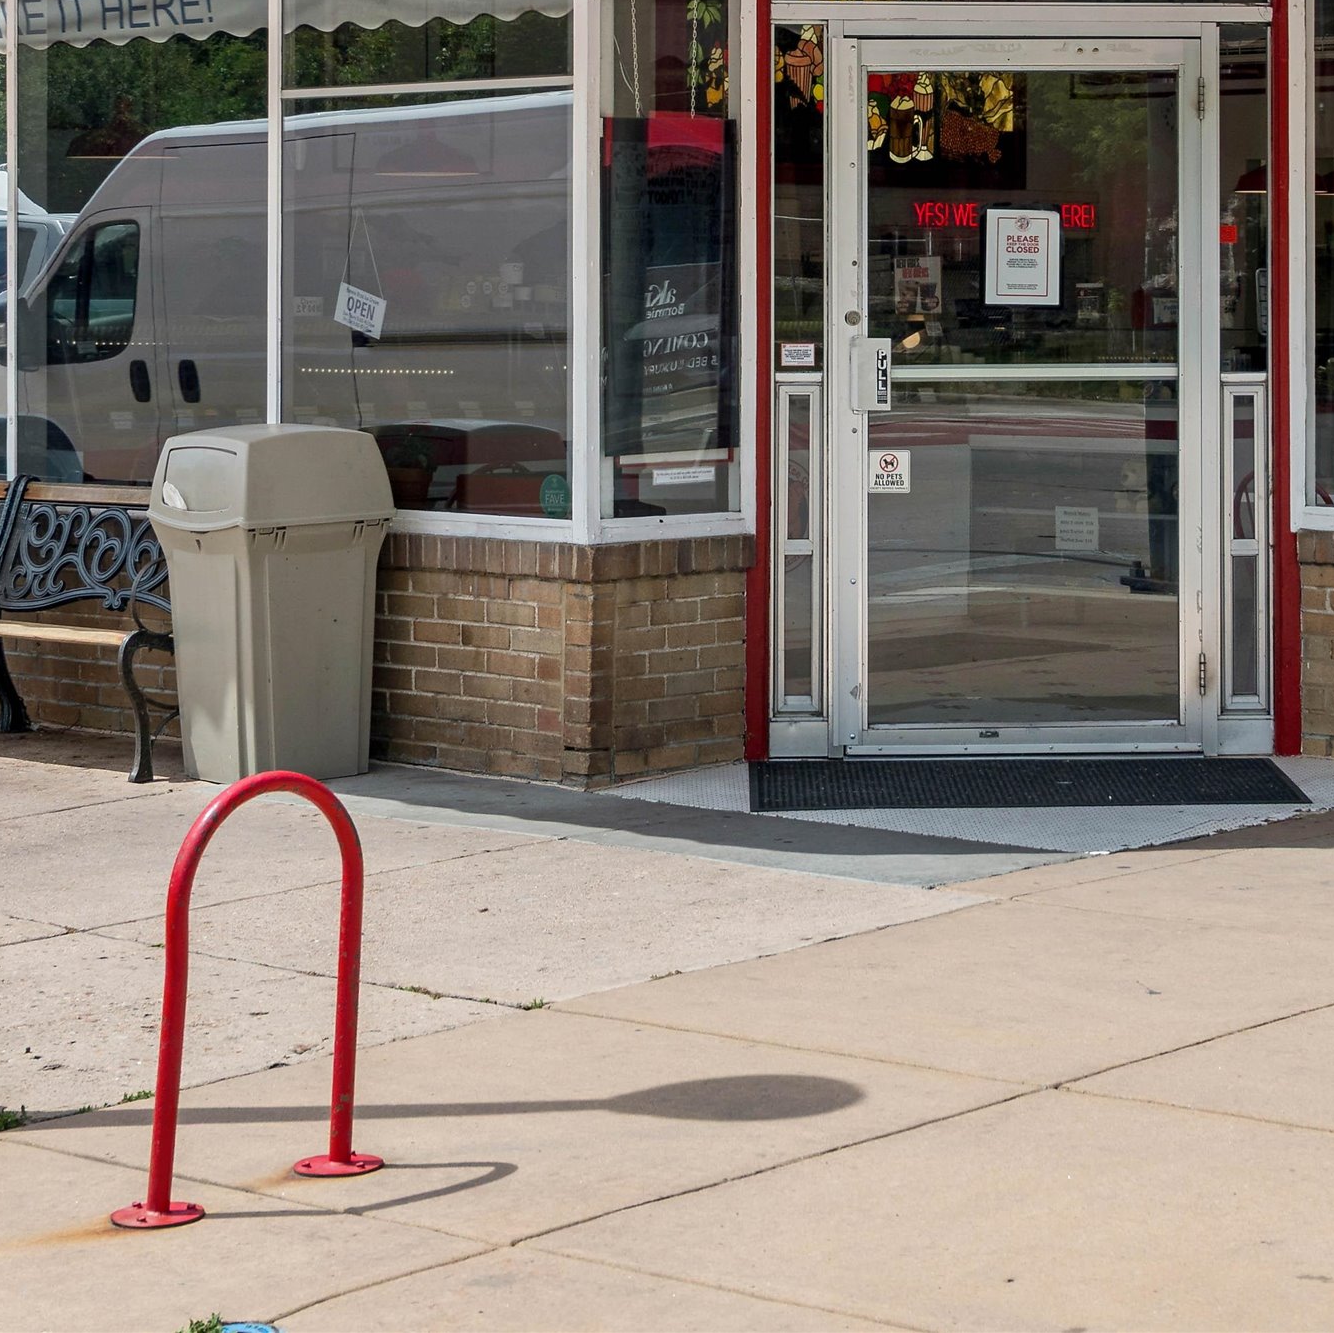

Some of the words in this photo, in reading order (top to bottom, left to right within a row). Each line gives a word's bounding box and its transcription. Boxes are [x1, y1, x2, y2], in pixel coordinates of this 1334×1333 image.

[913, 202, 949, 227] YES!
[952, 202, 980, 227] WE
[1061, 203, 1096, 228] ERE!
[1006, 246, 1040, 254] CLOSED
[347, 296, 376, 321] OPEN
[877, 349, 887, 390] PULL
